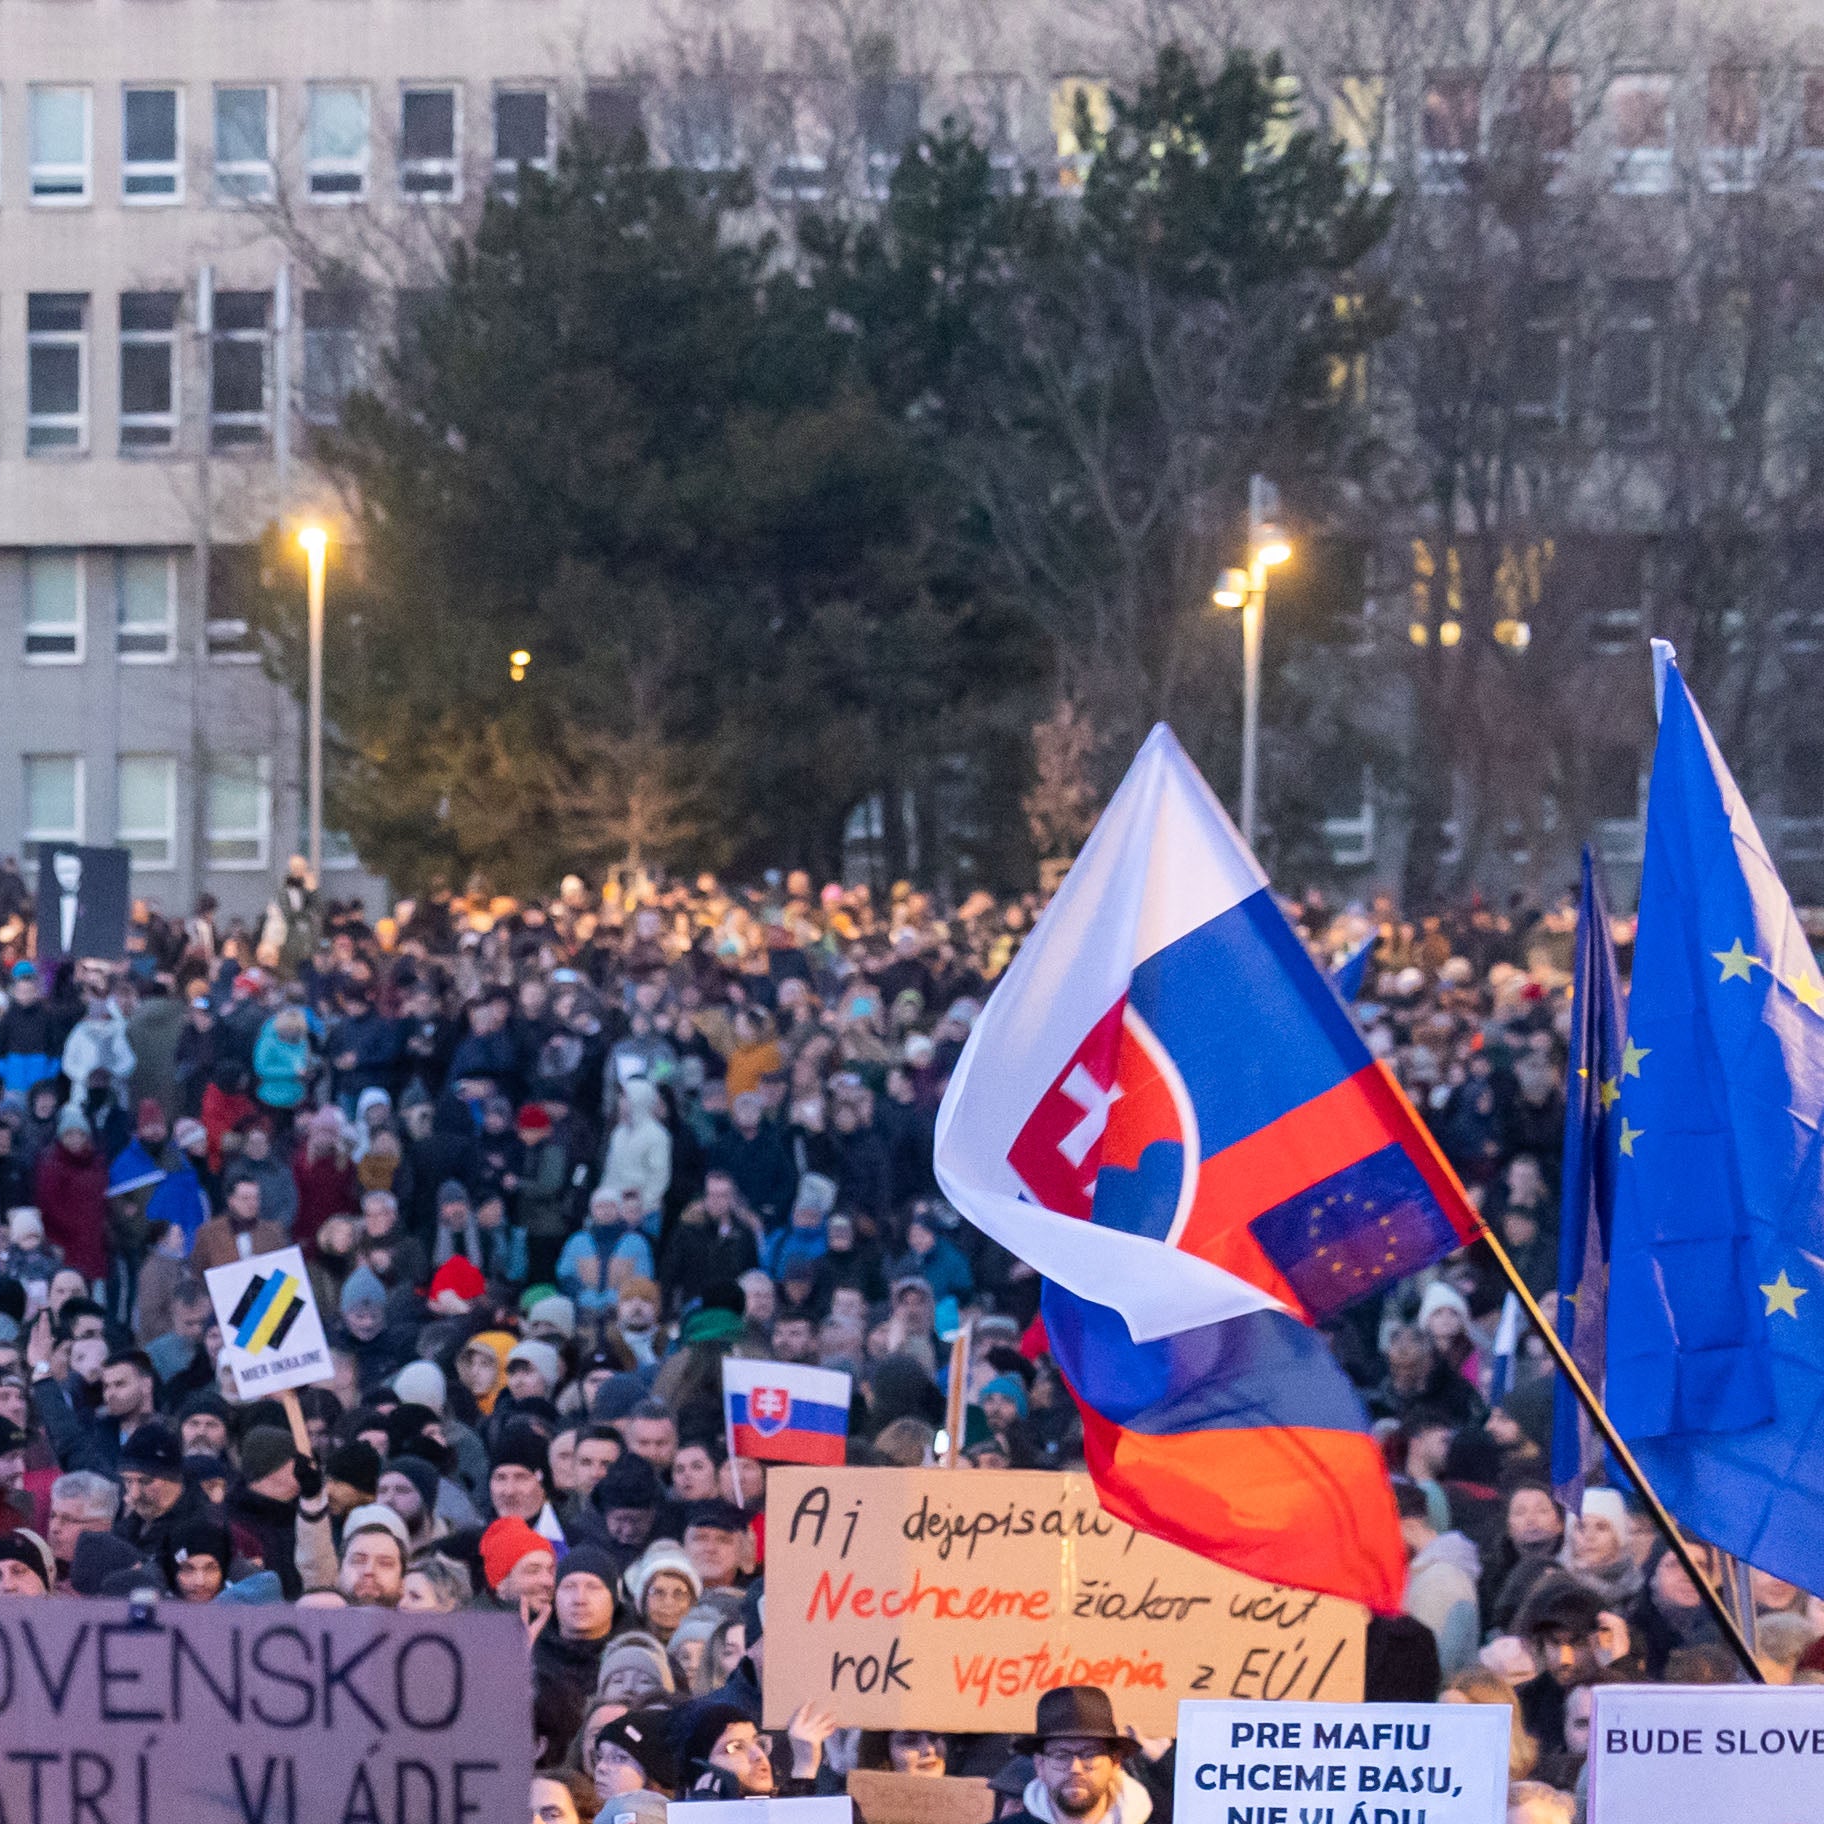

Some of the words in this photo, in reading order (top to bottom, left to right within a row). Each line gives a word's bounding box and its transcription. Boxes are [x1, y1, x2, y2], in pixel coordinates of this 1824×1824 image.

[789, 1485, 862, 1560] Aj
[805, 1568, 1053, 1625] Nechceme
[1072, 1576, 1211, 1622] žiakov
[830, 1637, 914, 1694] rok
[952, 1641, 1168, 1708] vystúpenia
[1190, 1664, 1215, 1689] z
[1230, 1722, 1302, 1751] PRE
[1312, 1722, 1433, 1752] MAFIU
[1606, 1729, 1704, 1756] BUDE
[1194, 1763, 1348, 1794] CHCEME
[1358, 1766, 1464, 1798] BASU,
